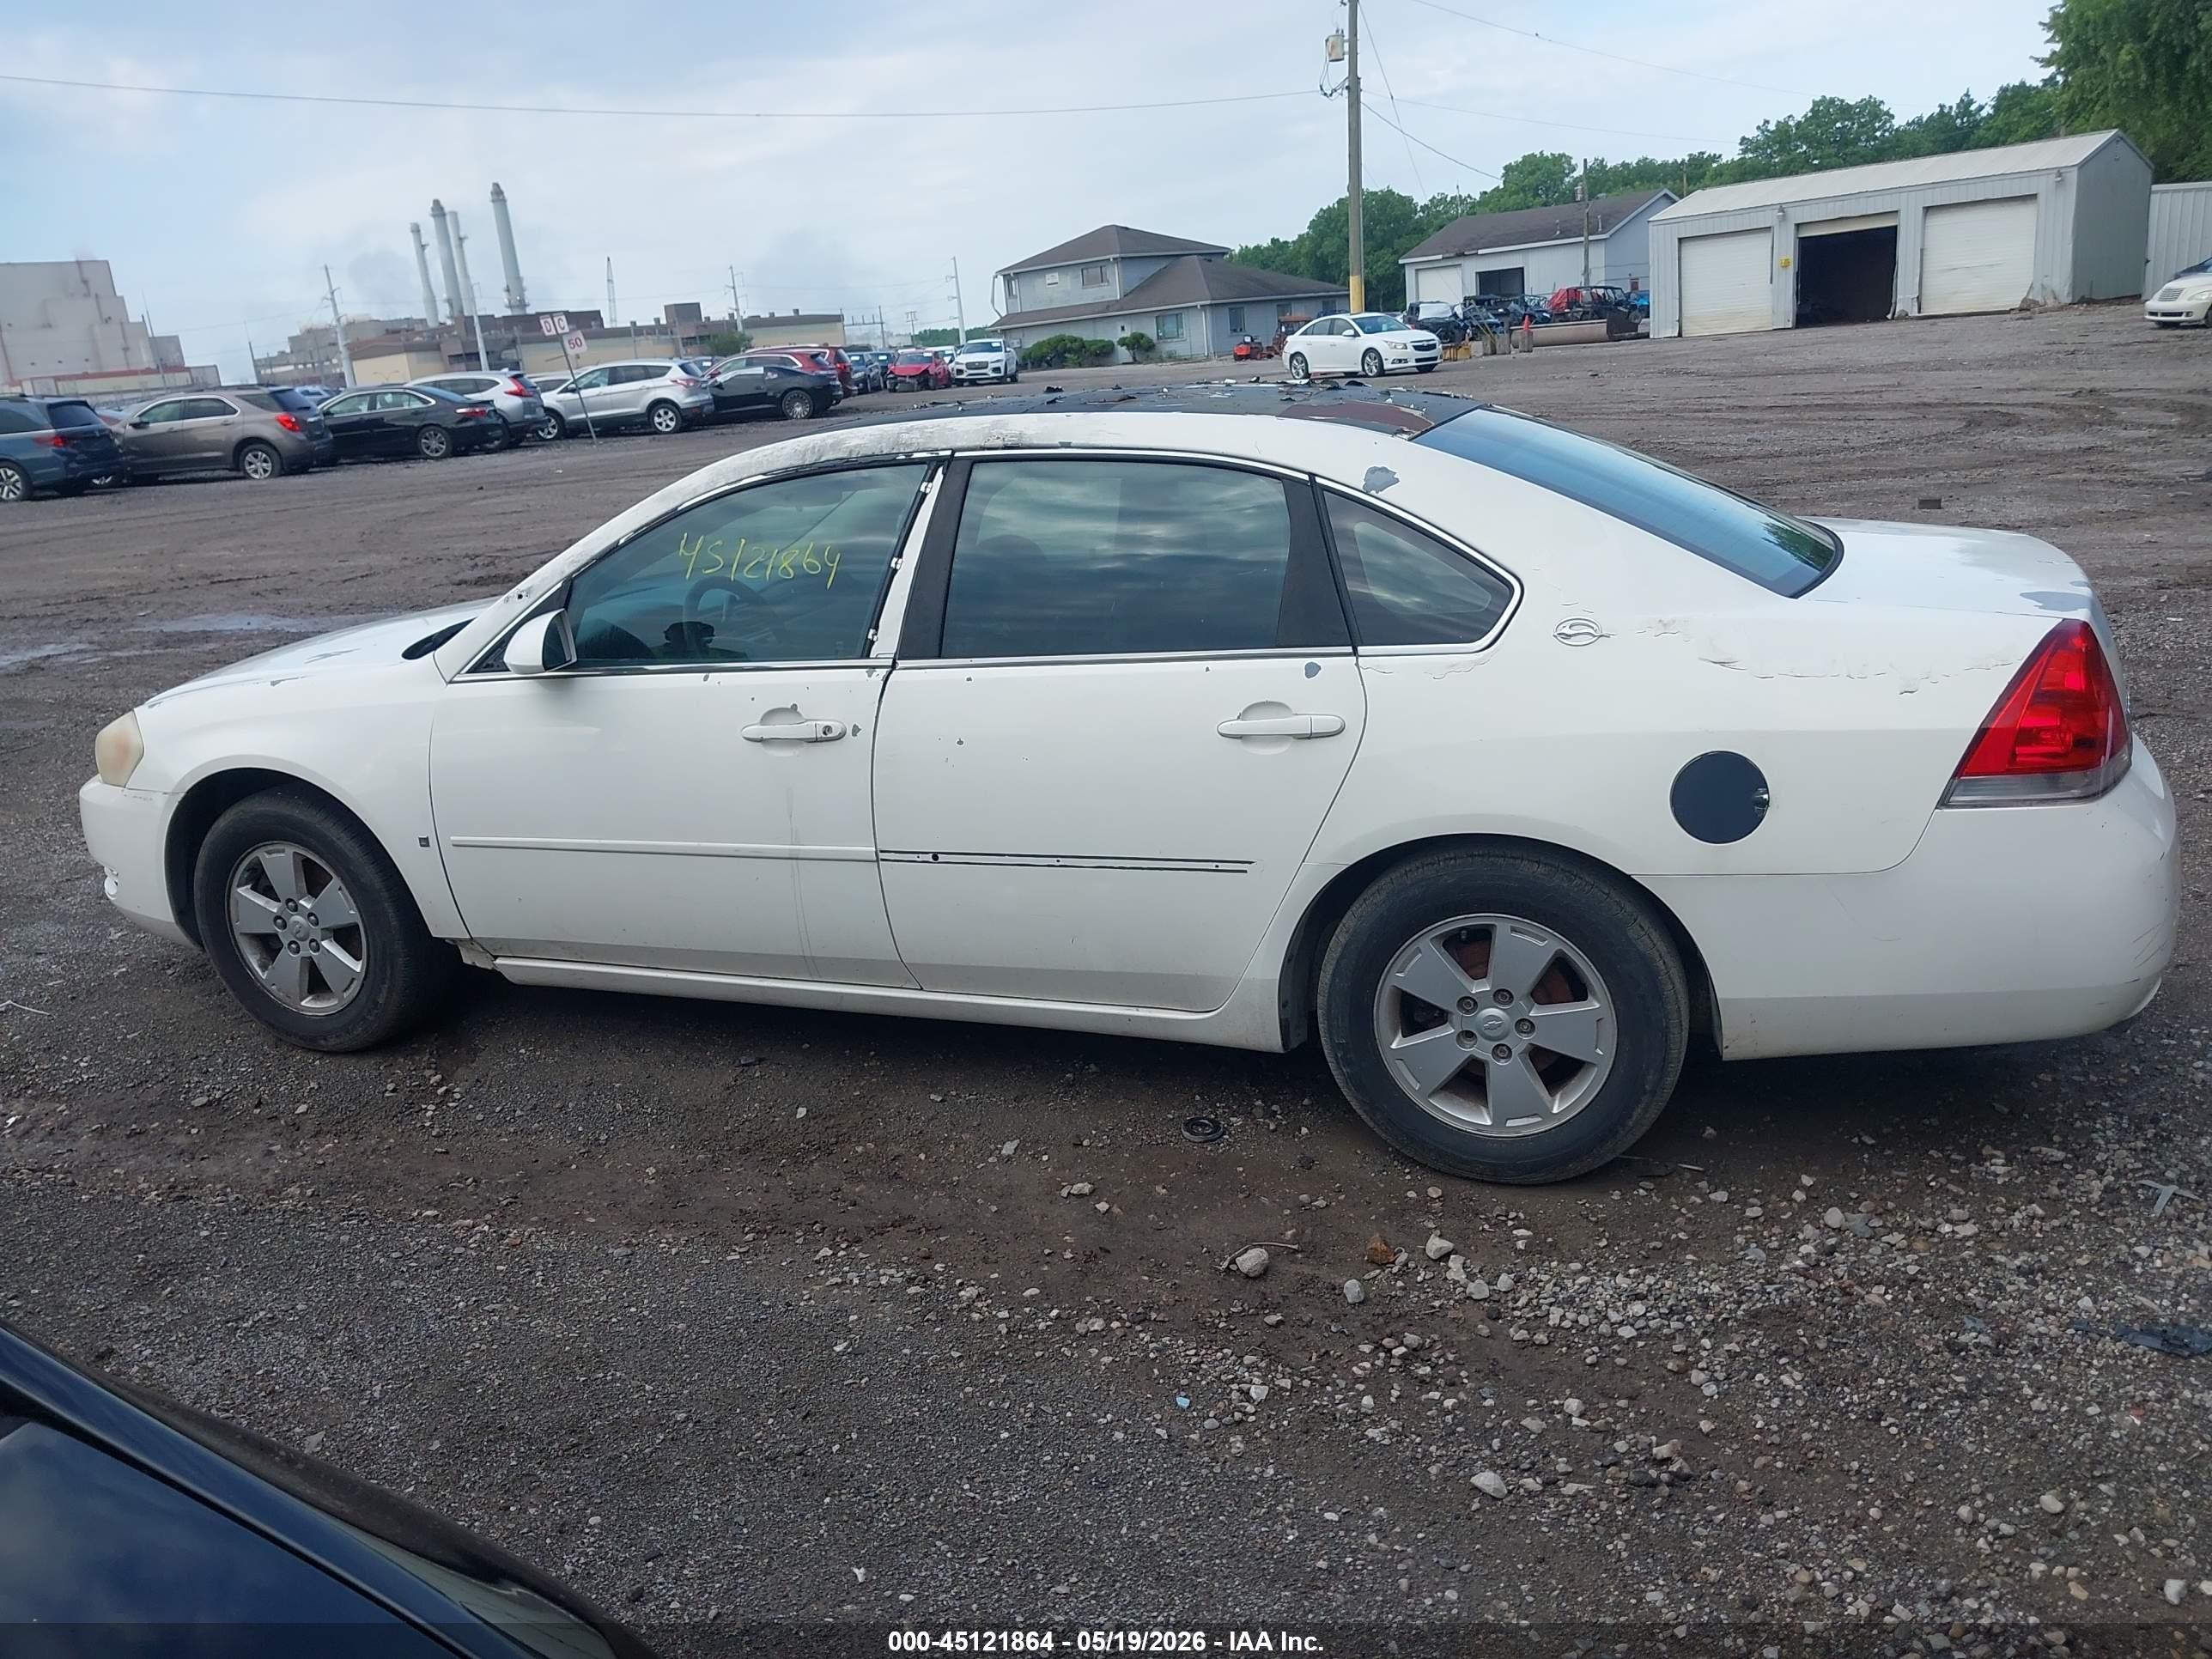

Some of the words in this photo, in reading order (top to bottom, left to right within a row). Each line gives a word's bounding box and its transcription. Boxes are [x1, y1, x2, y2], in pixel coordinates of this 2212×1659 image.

[557, 318, 566, 331] C
[568, 337, 583, 349] 50
[679, 532, 842, 591] 45121864
